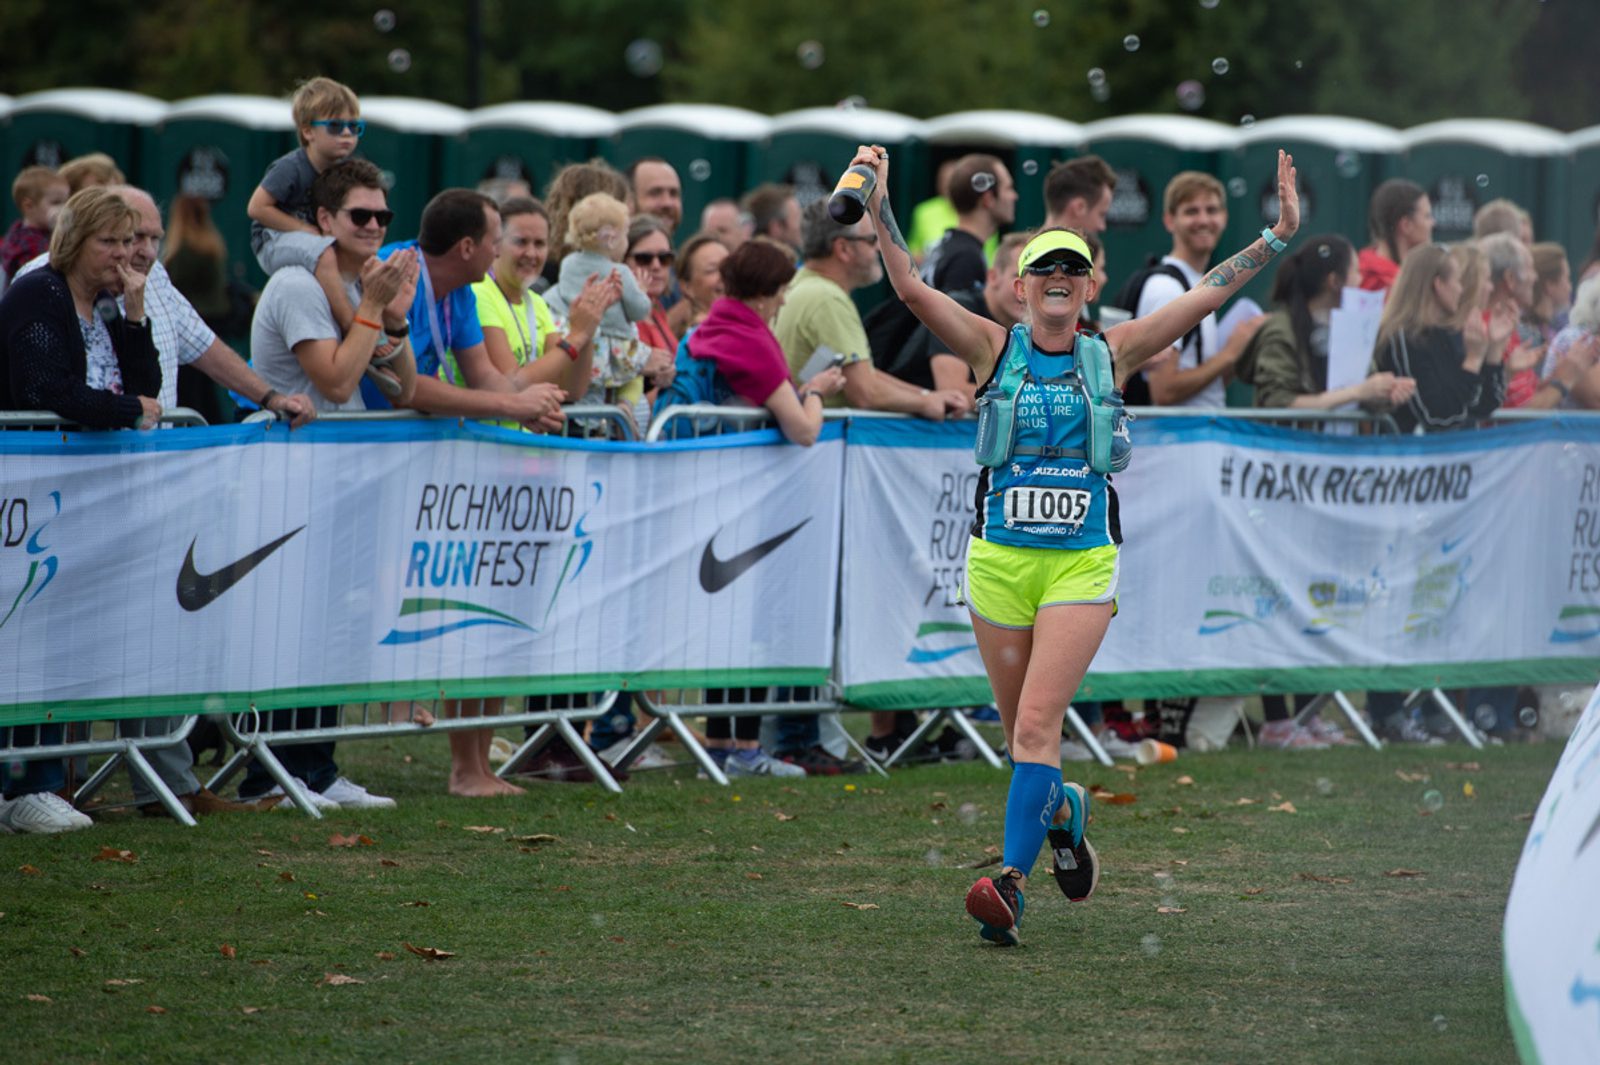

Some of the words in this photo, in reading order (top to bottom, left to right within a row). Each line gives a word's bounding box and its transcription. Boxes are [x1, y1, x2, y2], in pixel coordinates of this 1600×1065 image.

[1030, 405, 1039, 416] A
[415, 483, 575, 532] RICHMOND
[1012, 490, 1087, 520] 11005
[405, 541, 550, 587] RUNFEST
